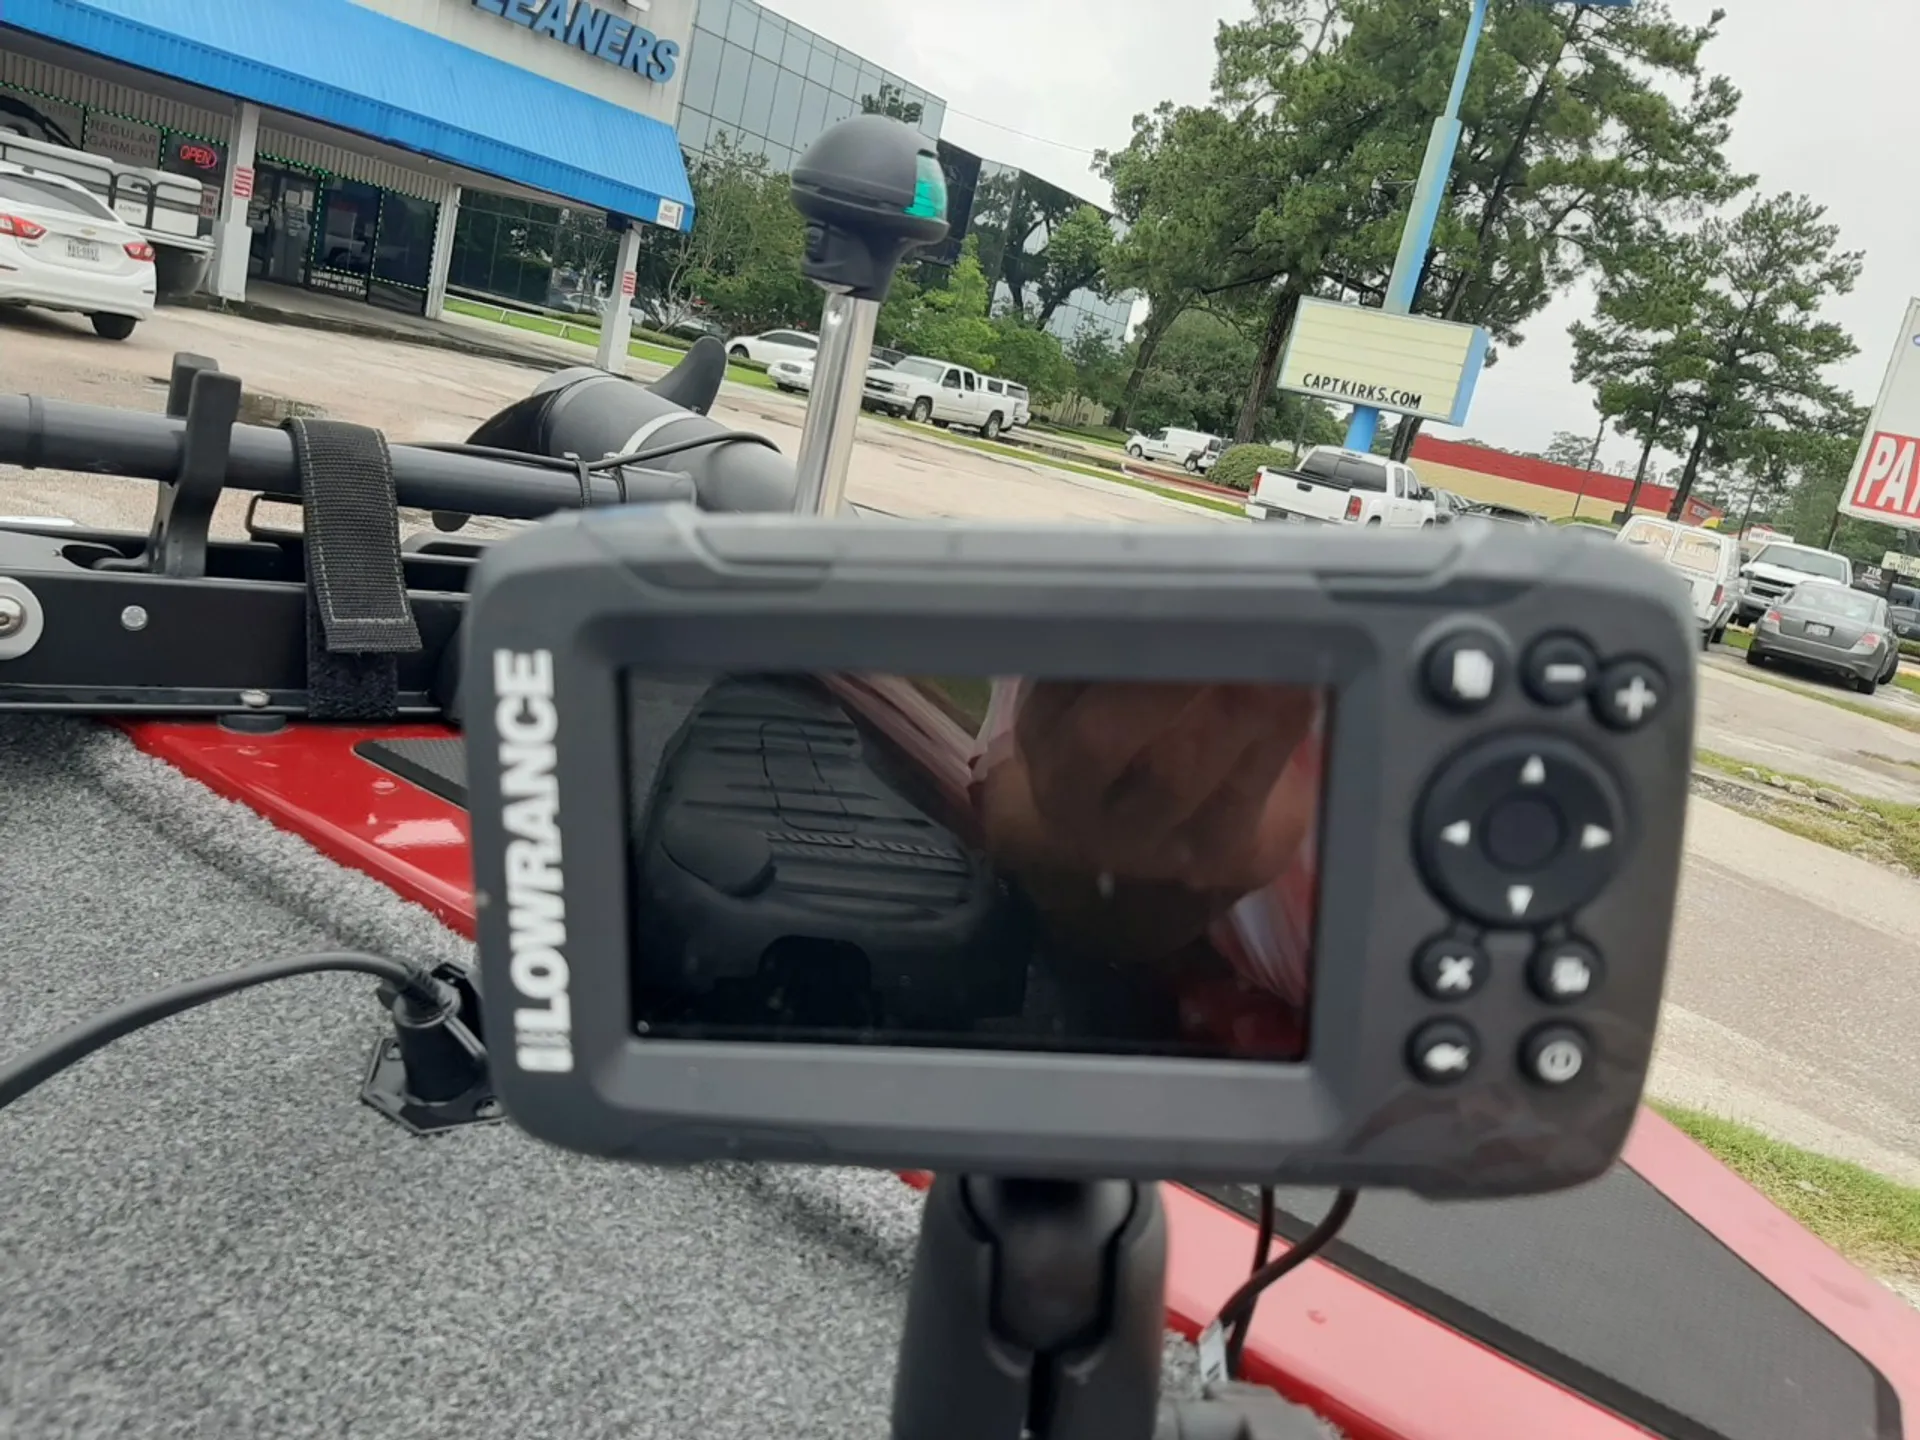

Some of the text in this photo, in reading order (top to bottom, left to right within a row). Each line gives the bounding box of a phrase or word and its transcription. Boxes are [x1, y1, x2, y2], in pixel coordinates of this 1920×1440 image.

[181, 145, 211, 165] OPEN
[1302, 373, 1422, 409] CAPTKIRKS.COM
[494, 648, 573, 1033] LOWRANCE
